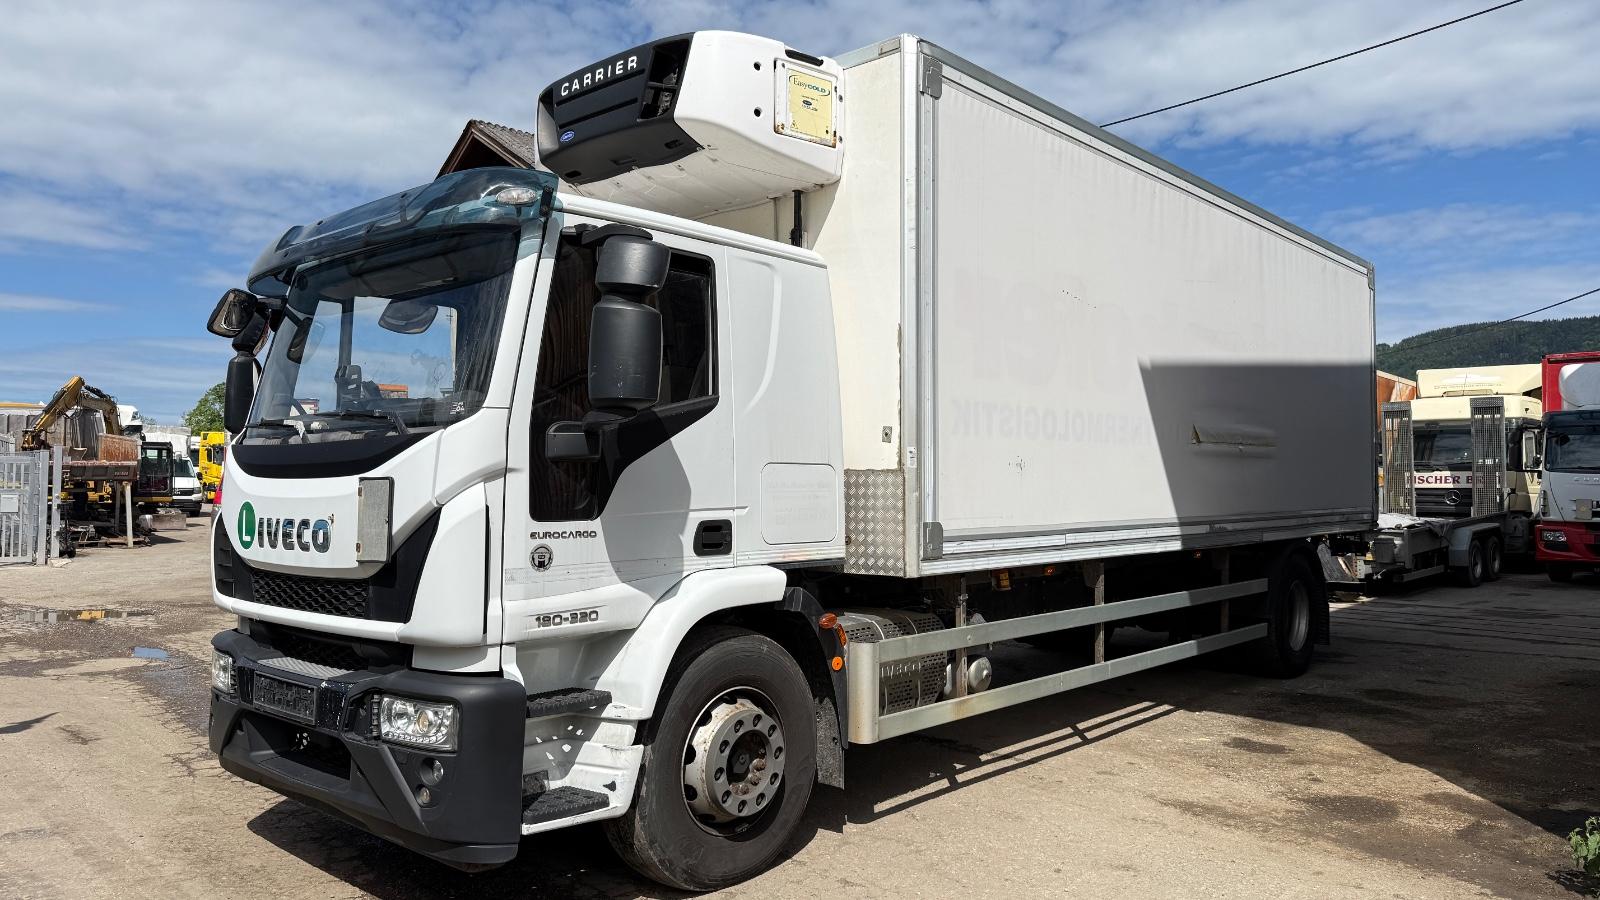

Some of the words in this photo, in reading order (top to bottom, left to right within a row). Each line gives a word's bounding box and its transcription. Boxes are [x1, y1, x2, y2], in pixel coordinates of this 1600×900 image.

[560, 55, 638, 96] CARRIER
[242, 509, 251, 542] L
[257, 517, 332, 553] IVECO
[530, 530, 597, 539] EUROCARGO
